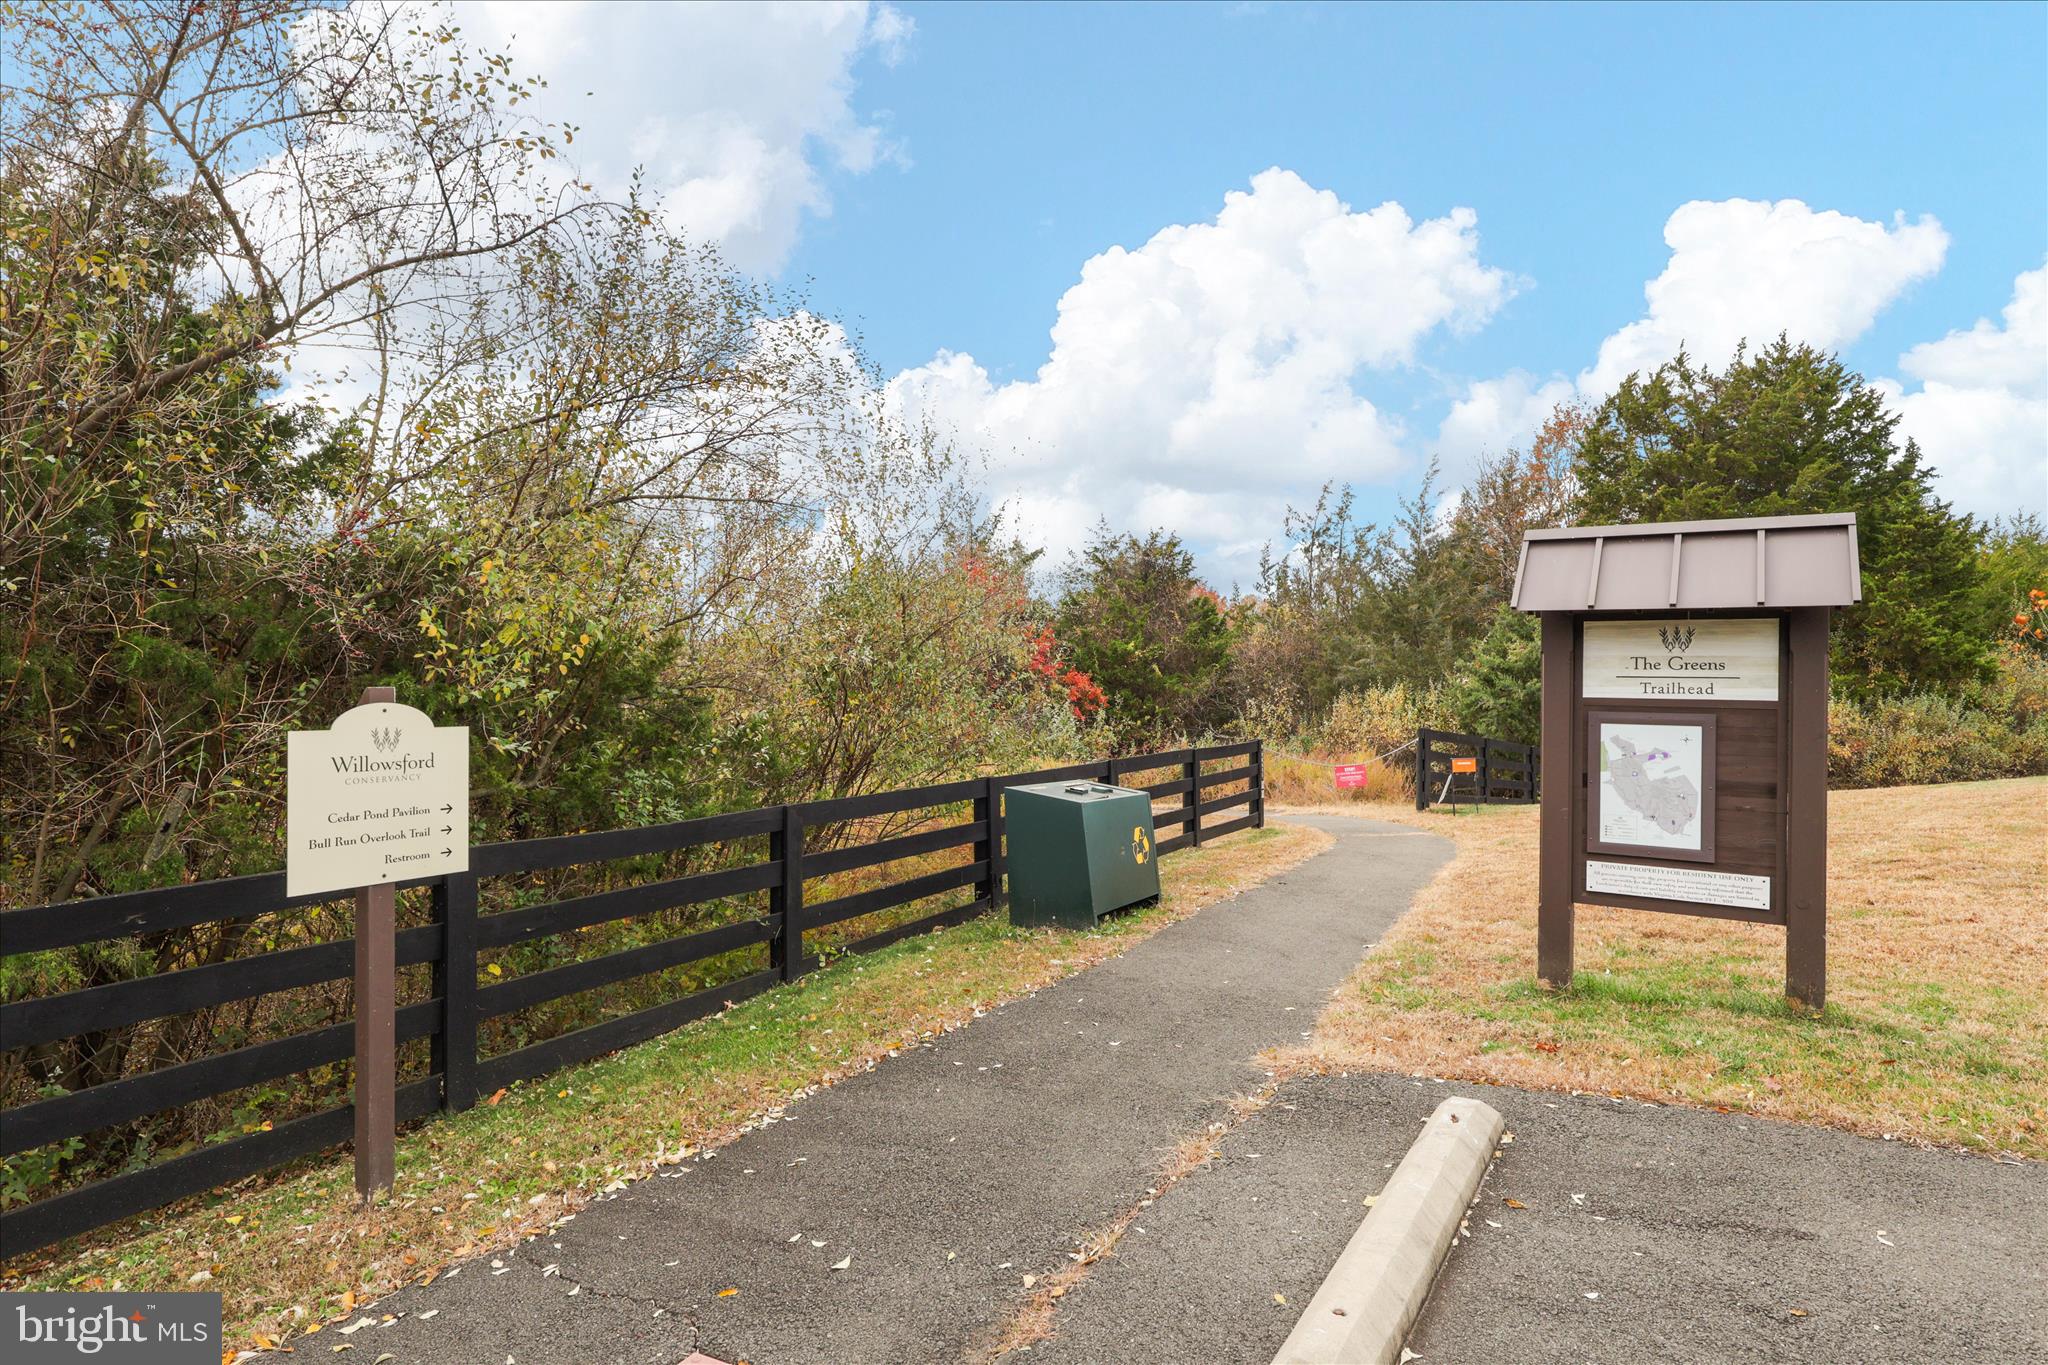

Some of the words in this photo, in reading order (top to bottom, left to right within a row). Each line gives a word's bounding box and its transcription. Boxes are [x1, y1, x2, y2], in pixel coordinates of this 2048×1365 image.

[1630, 656, 1662, 671] The
[1668, 656, 1726, 672] Greens
[1640, 682, 1714, 695] Trailhead
[331, 752, 435, 774] Willowsford
[344, 773, 422, 786] CONSERVANCY
[327, 812, 360, 824] Cedar
[363, 809, 389, 820] Pond
[392, 806, 431, 818] Pavilion
[308, 838, 331, 850] Bull
[335, 836, 357, 847] Run
[360, 831, 407, 844] Overlook
[408, 827, 431, 839] Trail
[384, 851, 430, 864] Restroom
[1630, 866, 1664, 874] PROPERTY
